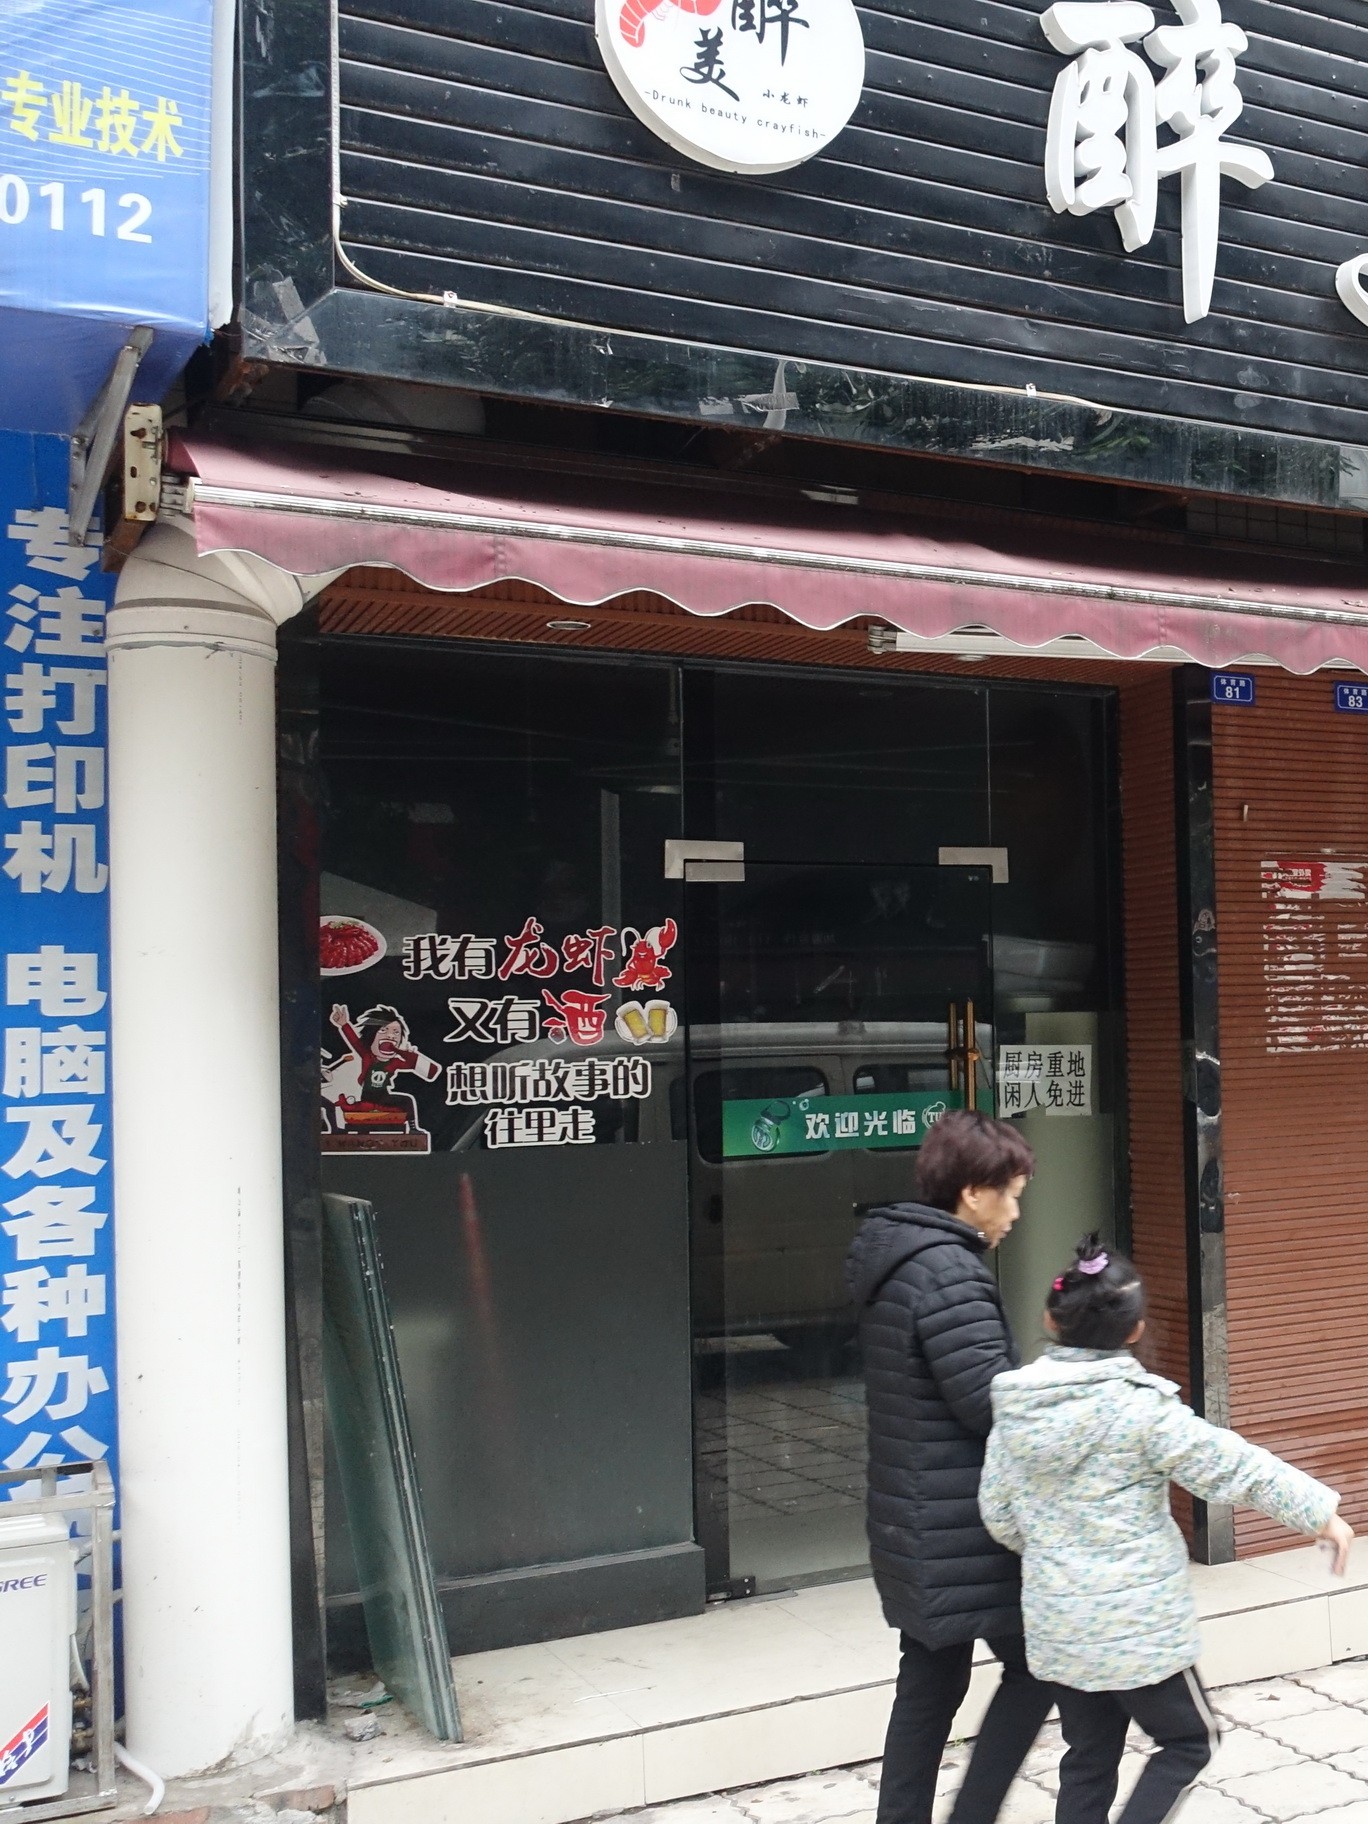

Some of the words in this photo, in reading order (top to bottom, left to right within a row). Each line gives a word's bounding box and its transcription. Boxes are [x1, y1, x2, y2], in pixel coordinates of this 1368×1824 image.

[1, 70, 184, 162] 专业技术
[701, 102, 748, 125] beauty
[0, 173, 153, 244] 0112
[3, 506, 108, 895] 专注打印机
[1225, 686, 1240, 700] 81
[1348, 695, 1363, 708] 83
[402, 916, 618, 987] 我有龙虾
[443, 988, 612, 1046] 又有酒
[445, 1055, 652, 1106] 想听故事的
[1002, 1049, 1087, 1079] 厨房重地
[1002, 1080, 1087, 1109] 闲人免进
[483, 1105, 597, 1150] 往里走
[804, 1108, 917, 1140] 欢迎光临
